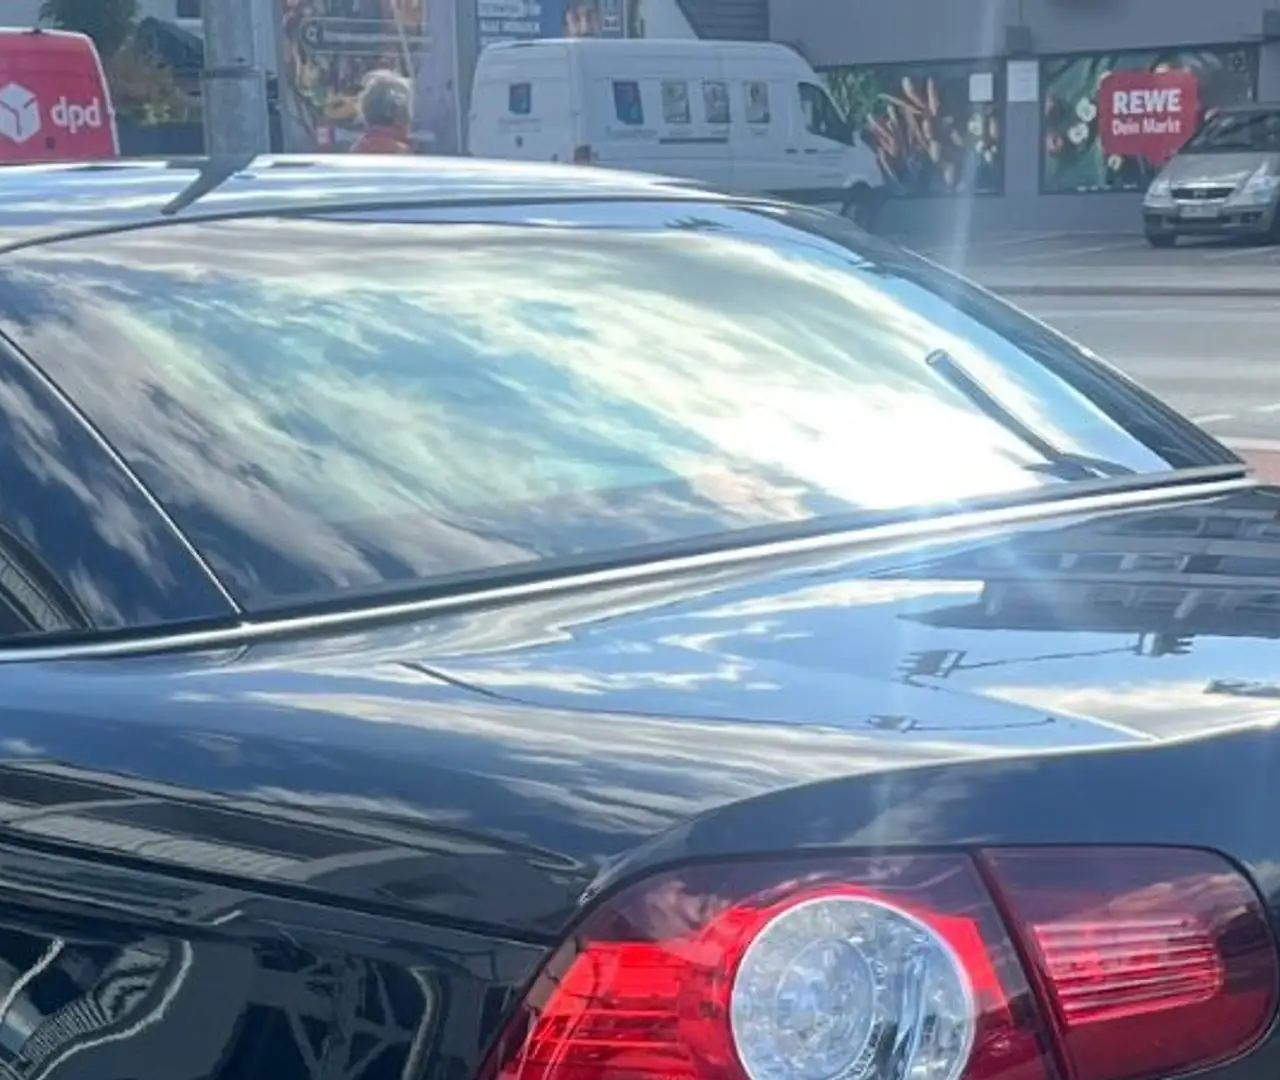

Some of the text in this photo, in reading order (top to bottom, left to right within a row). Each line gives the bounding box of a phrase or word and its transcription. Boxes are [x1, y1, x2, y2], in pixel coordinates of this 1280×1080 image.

[51, 95, 101, 134] dpd
[1112, 88, 1182, 115] REWE
[1112, 115, 1181, 136] Dein Markt
